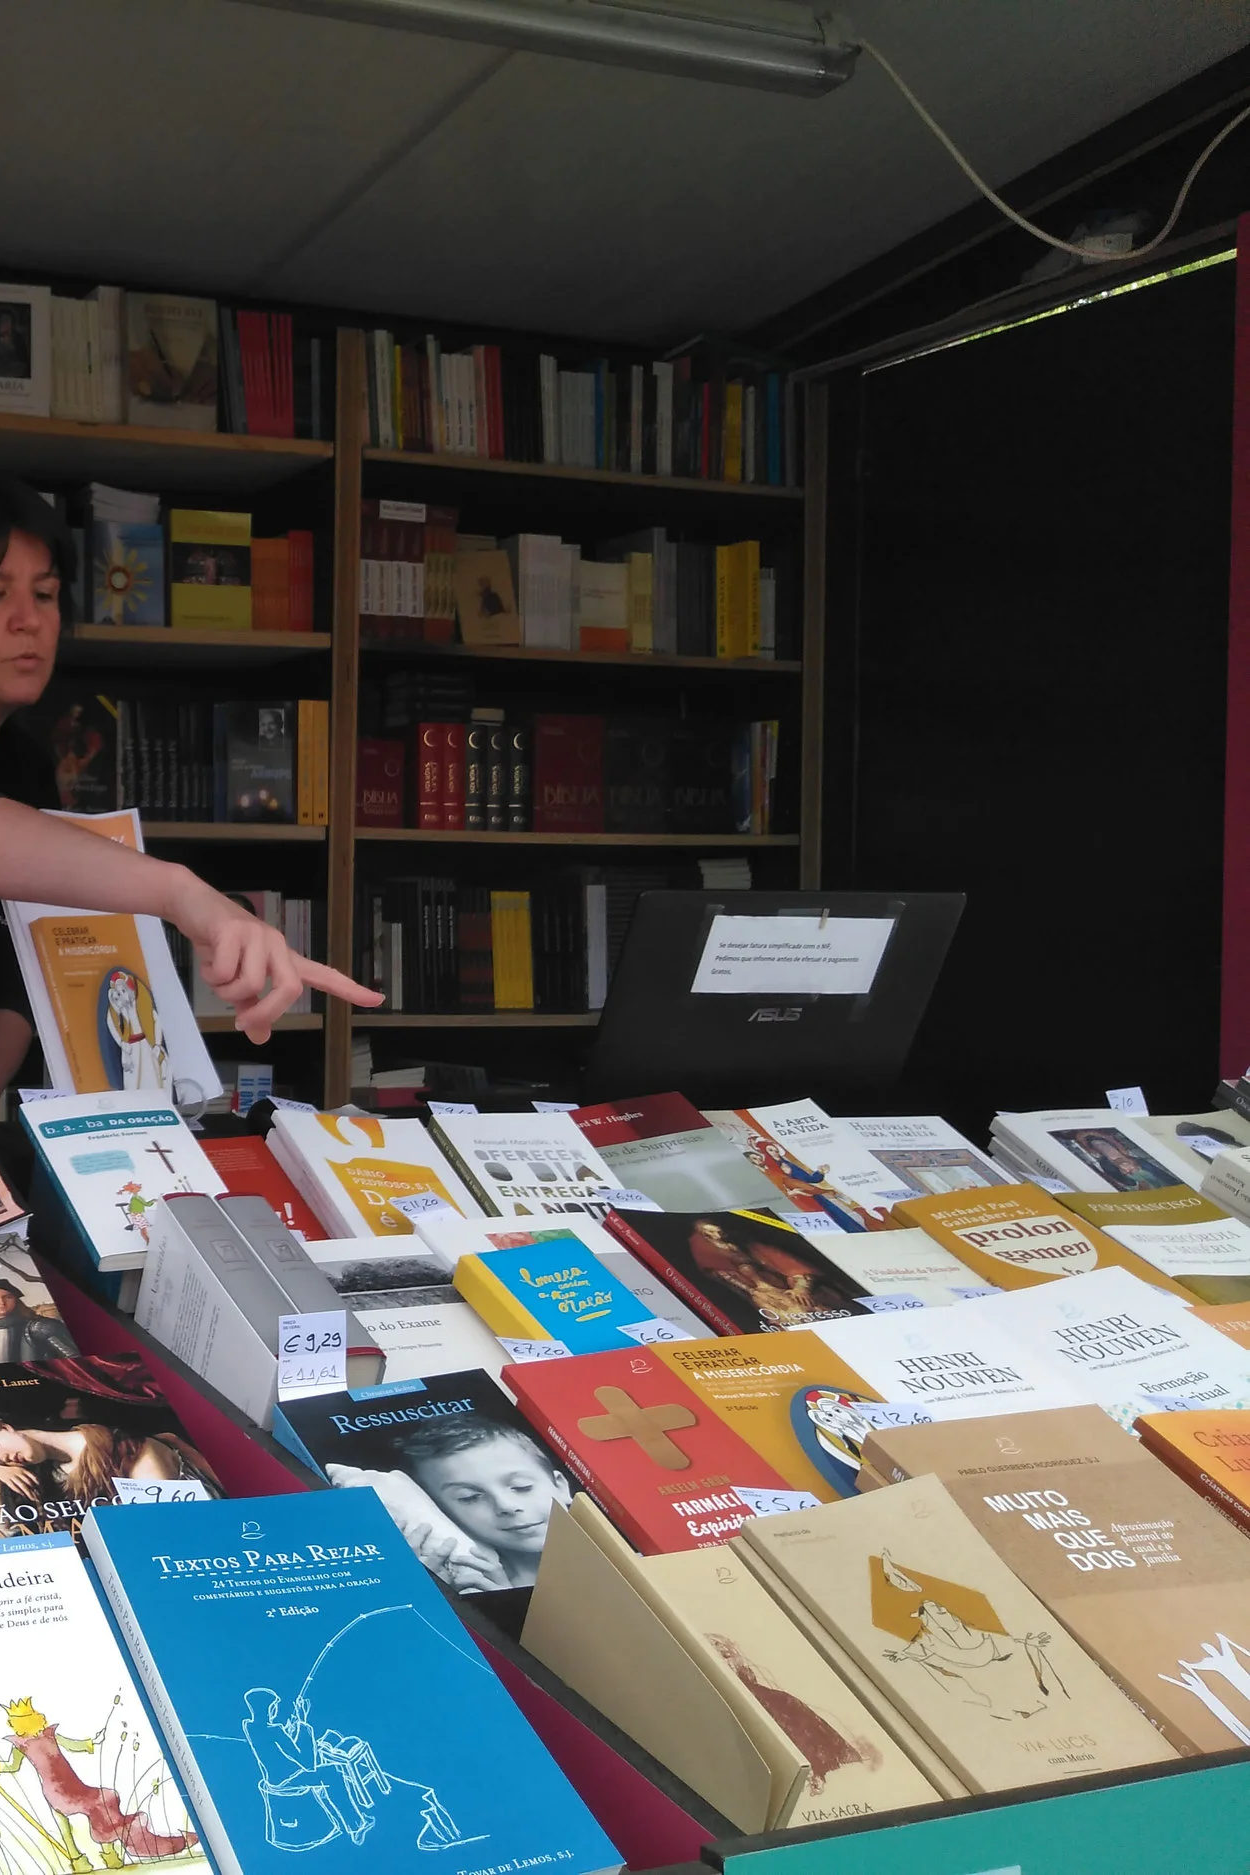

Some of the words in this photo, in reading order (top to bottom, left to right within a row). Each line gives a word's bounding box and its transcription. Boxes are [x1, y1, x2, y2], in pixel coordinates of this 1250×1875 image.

[748, 1008, 802, 1021] ASUS
[786, 1116, 818, 1126] ARTE
[799, 1123, 829, 1133] VIDA
[625, 1147, 638, 1155] de
[641, 1135, 703, 1153] Surpresas
[474, 1150, 586, 1161] OFERECER
[485, 1162, 513, 1181] O
[527, 1162, 603, 1182] DIA
[931, 1209, 984, 1221] Michael
[986, 1201, 1019, 1211] Paul
[1088, 1202, 1121, 1212] PAPA
[1121, 1198, 1202, 1211] FRANCISCO
[961, 1217, 1073, 1247] prolon
[994, 1238, 1091, 1264] gamen
[379, 1323, 396, 1331] do
[398, 1318, 441, 1330] Exame
[759, 1308, 780, 1321] O
[782, 1309, 851, 1322] regresso
[1052, 1314, 1143, 1344] HENRI
[284, 1337, 302, 1353] €
[305, 1332, 342, 1353] 9,29
[1057, 1324, 1182, 1364] NOUWEN
[673, 1348, 741, 1361] CELEBRAR
[682, 1361, 692, 1370] E
[694, 1357, 761, 1369] PRATICAR
[895, 1353, 986, 1375] HENRI
[693, 1372, 704, 1380] A
[705, 1364, 805, 1379] MISERICÓRDIA
[897, 1367, 1023, 1395] NOUWEN
[2, 1378, 40, 1387] Lamet
[1139, 1370, 1209, 1395] Formação
[330, 1396, 473, 1435] Ressuscitar
[658, 1481, 698, 1496] ANSELM
[700, 1475, 732, 1487] GRÜN
[42, 1502, 83, 1519] SEI
[983, 1491, 1068, 1512] MUITO
[1023, 1510, 1092, 1530] MAIS
[1110, 1519, 1175, 1537] Aproximação
[1054, 1529, 1109, 1550] QUE
[152, 1555, 240, 1573] TEXTOS
[243, 1550, 305, 1567] PARA
[306, 1544, 381, 1561] REZAR
[1067, 1550, 1137, 1572] DOIS
[1141, 1553, 1182, 1568] família
[8, 1608, 41, 1616] simples
[44, 1605, 63, 1614] para
[7, 1620, 30, 1628] Deus
[40, 1616, 49, 1624] de
[801, 1803, 874, 1822] VIA-SACRA
